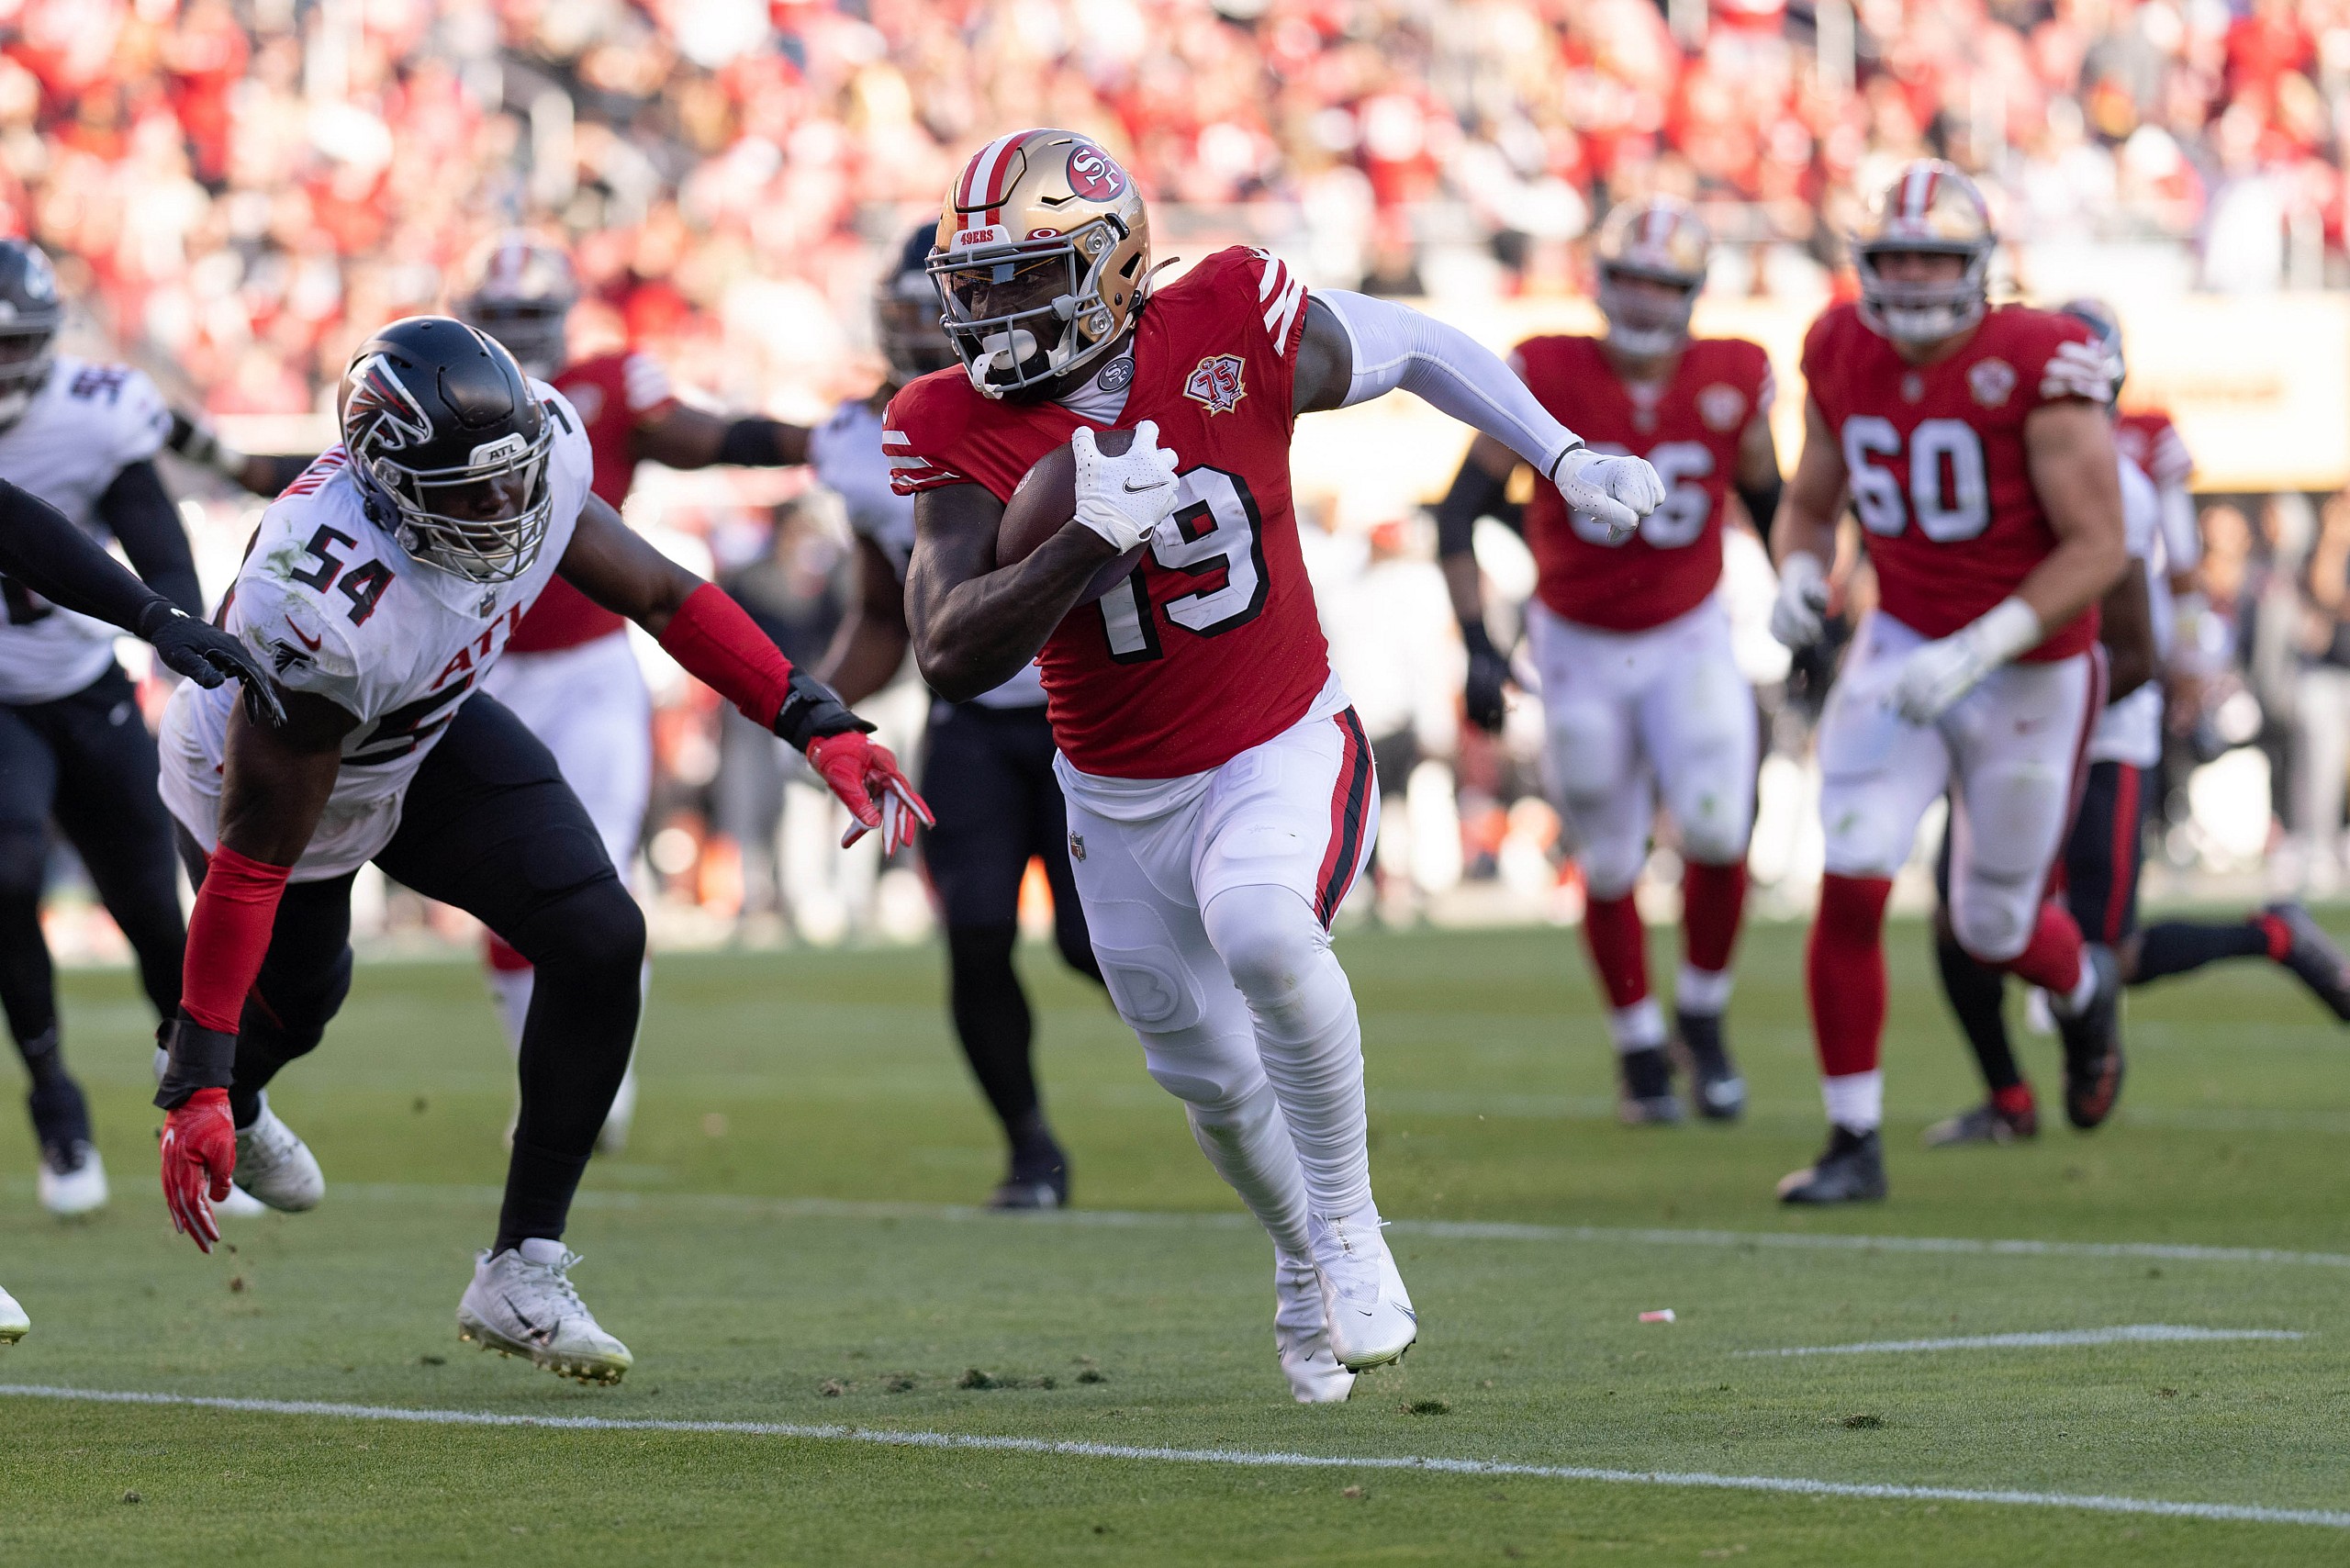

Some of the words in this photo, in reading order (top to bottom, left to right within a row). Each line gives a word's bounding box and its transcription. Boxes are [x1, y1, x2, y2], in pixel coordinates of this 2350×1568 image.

[960, 229, 994, 246] 49ERS
[1194, 362, 1239, 401] 75
[489, 443, 518, 461] ATL
[1841, 415, 1993, 543] 60
[289, 523, 396, 628] 54
